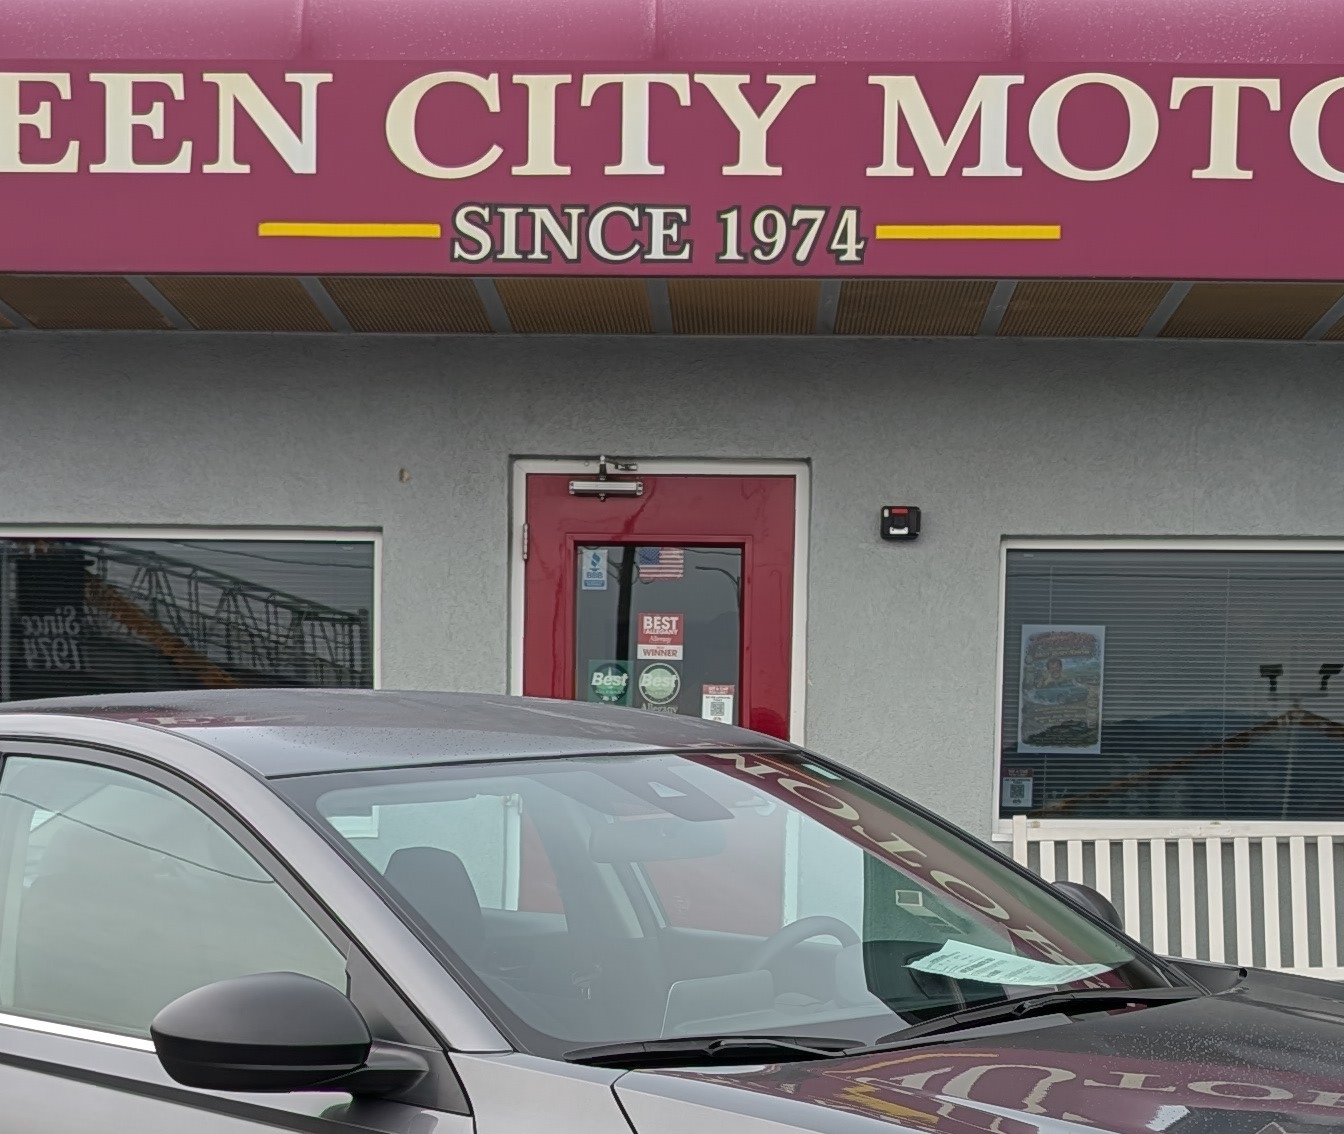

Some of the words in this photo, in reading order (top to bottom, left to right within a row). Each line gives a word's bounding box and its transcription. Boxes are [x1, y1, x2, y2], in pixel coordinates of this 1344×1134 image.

[384, 70, 817, 181] CITY
[452, 205, 692, 262] SINCE
[718, 206, 866, 263] 1974
[643, 615, 679, 630] BEST
[642, 648, 678, 658] WINNER
[591, 671, 629, 687] Best
[639, 673, 677, 688] Best
